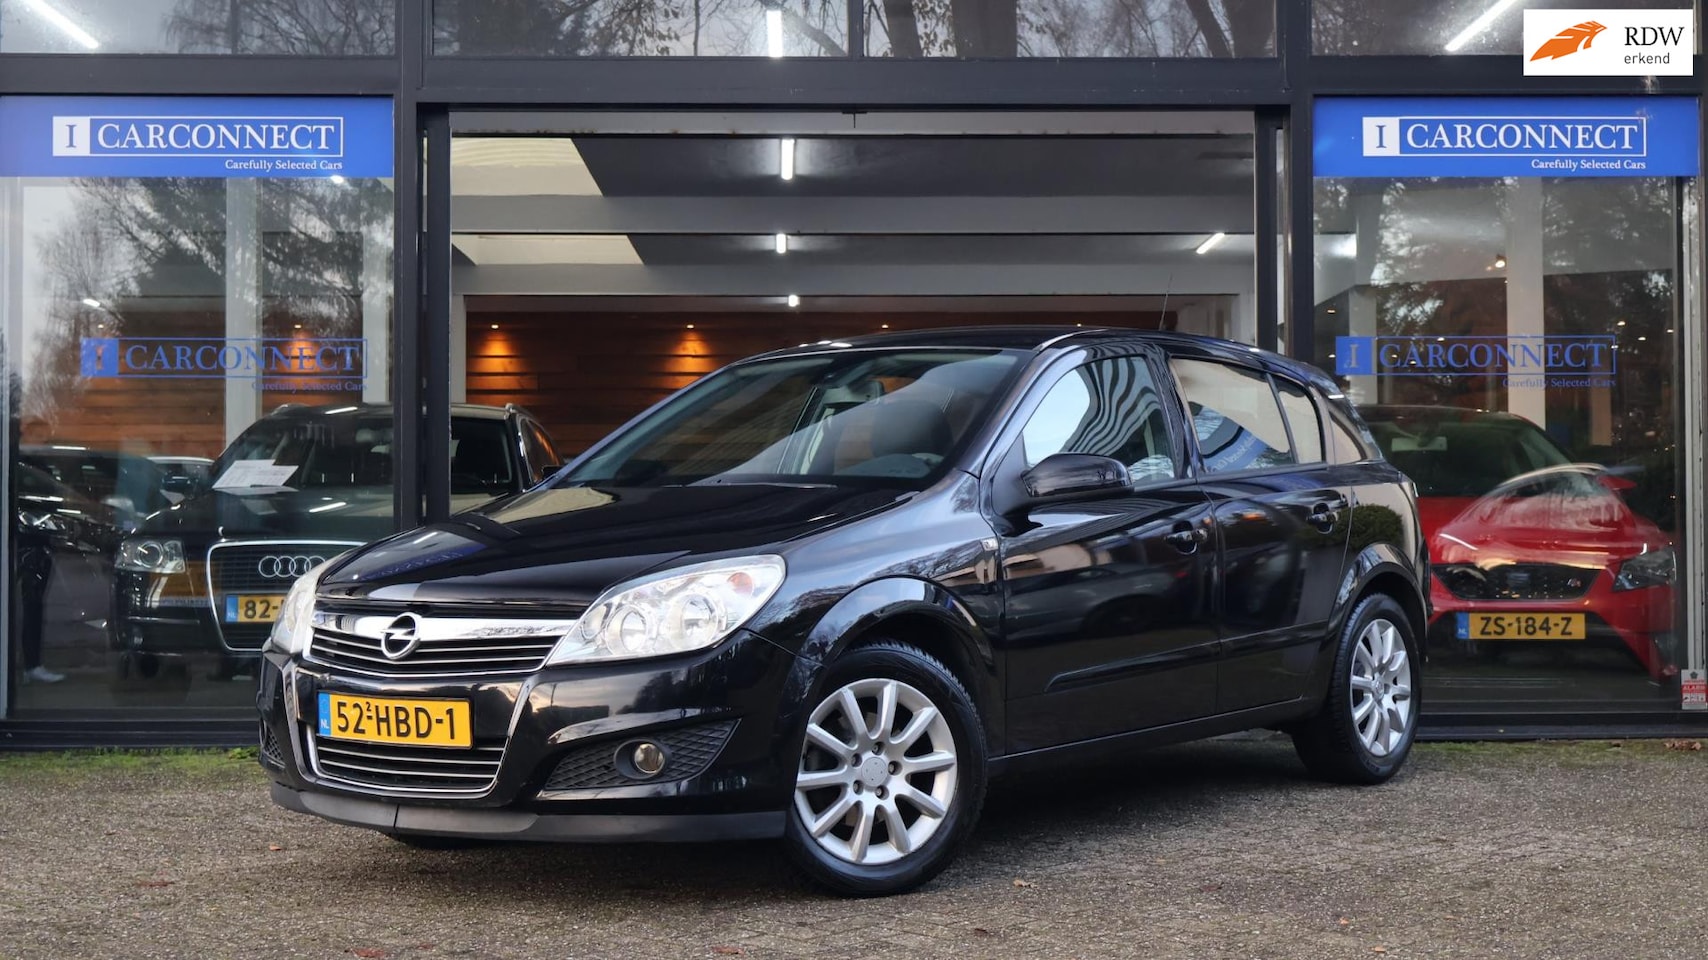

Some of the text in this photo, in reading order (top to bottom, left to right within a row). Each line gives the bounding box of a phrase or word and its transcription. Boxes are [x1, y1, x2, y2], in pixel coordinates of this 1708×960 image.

[97, 123, 335, 150] CARCONNECT
[1406, 123, 1638, 150] CARCONNECT
[225, 159, 343, 172] Carefully Selected Cars
[1531, 159, 1646, 172] Carefully Selected Cars
[125, 344, 358, 371] CARCONNECT
[1379, 343, 1608, 370] CARCONNECT
[344, 381, 368, 391] Cars
[1551, 377, 1591, 388] Selected
[244, 599, 284, 619] 82-
[1480, 616, 1572, 636] ZS-184-Z
[320, 718, 329, 729] NL
